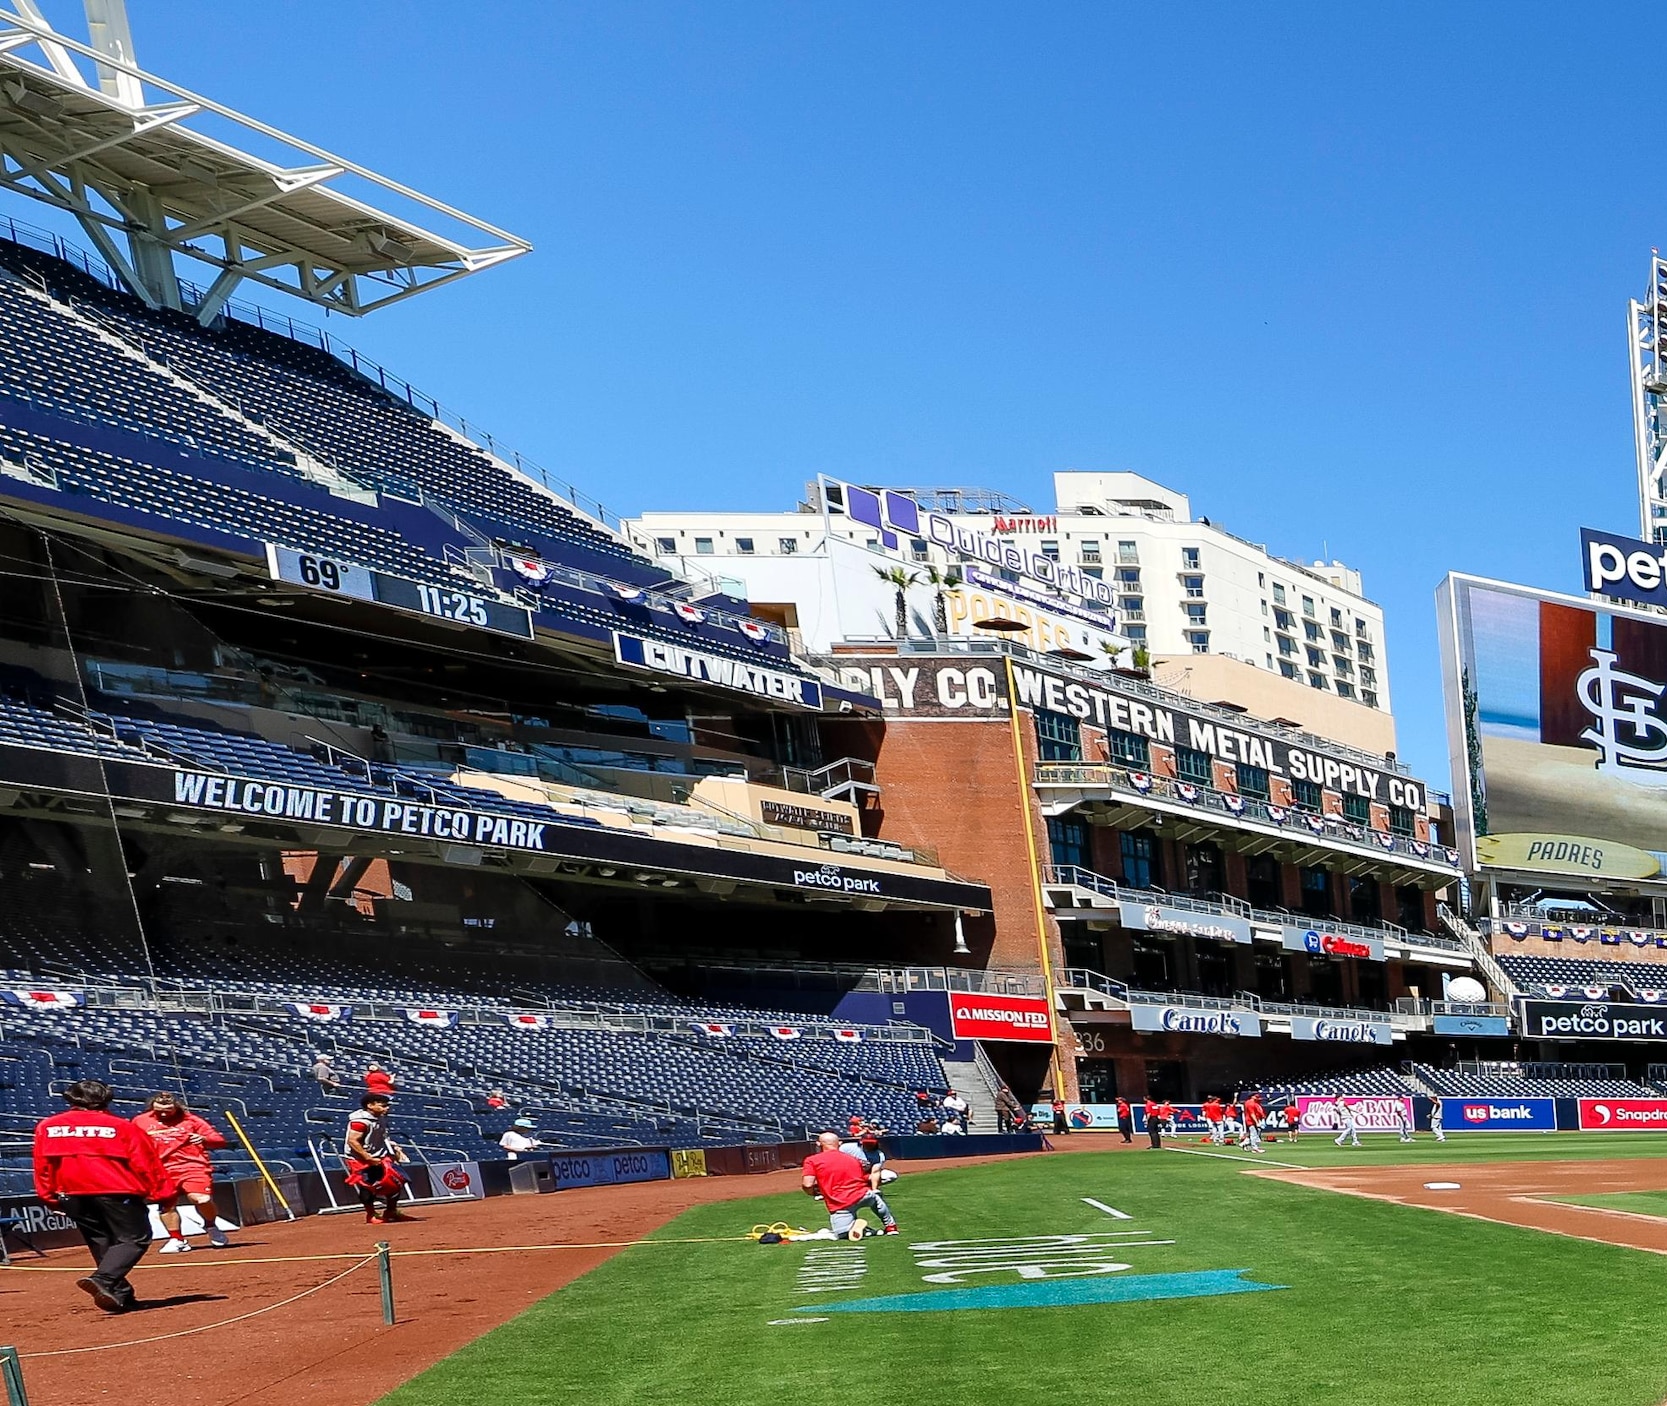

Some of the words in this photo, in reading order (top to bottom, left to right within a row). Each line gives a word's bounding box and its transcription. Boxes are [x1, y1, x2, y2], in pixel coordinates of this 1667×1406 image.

[991, 516, 1058, 535] Marriott
[299, 555, 349, 590] 69°
[930, 514, 1114, 605] QuidelOrtho
[416, 585, 488, 626] 11:25
[643, 641, 805, 704] CUTWATER
[936, 666, 1009, 711] CO.
[1012, 665, 1176, 744] WESTERN
[1188, 719, 1283, 774] METAL
[1288, 749, 1381, 799] SUPPLY
[1389, 777, 1426, 812] CO.
[175, 772, 333, 822] WELCOME
[340, 796, 376, 827] TO
[383, 801, 470, 840] PETCO
[475, 814, 545, 850] PARK
[1527, 840, 1604, 870] PADRES
[794, 869, 841, 888] petco
[844, 877, 880, 893] park
[972, 1008, 1024, 1023] MISSION
[1025, 1012, 1048, 1024] FED
[1160, 1007, 1241, 1035] Canel's
[1541, 1013, 1609, 1036] petco
[1614, 1016, 1664, 1038] park
[1466, 1107, 1486, 1119] us
[1489, 1105, 1533, 1119] bank
[47, 1126, 117, 1139] ELITE
[614, 1155, 648, 1182] petco
[10, 1206, 47, 1233] AIR
[47, 1216, 77, 1231] GUA
